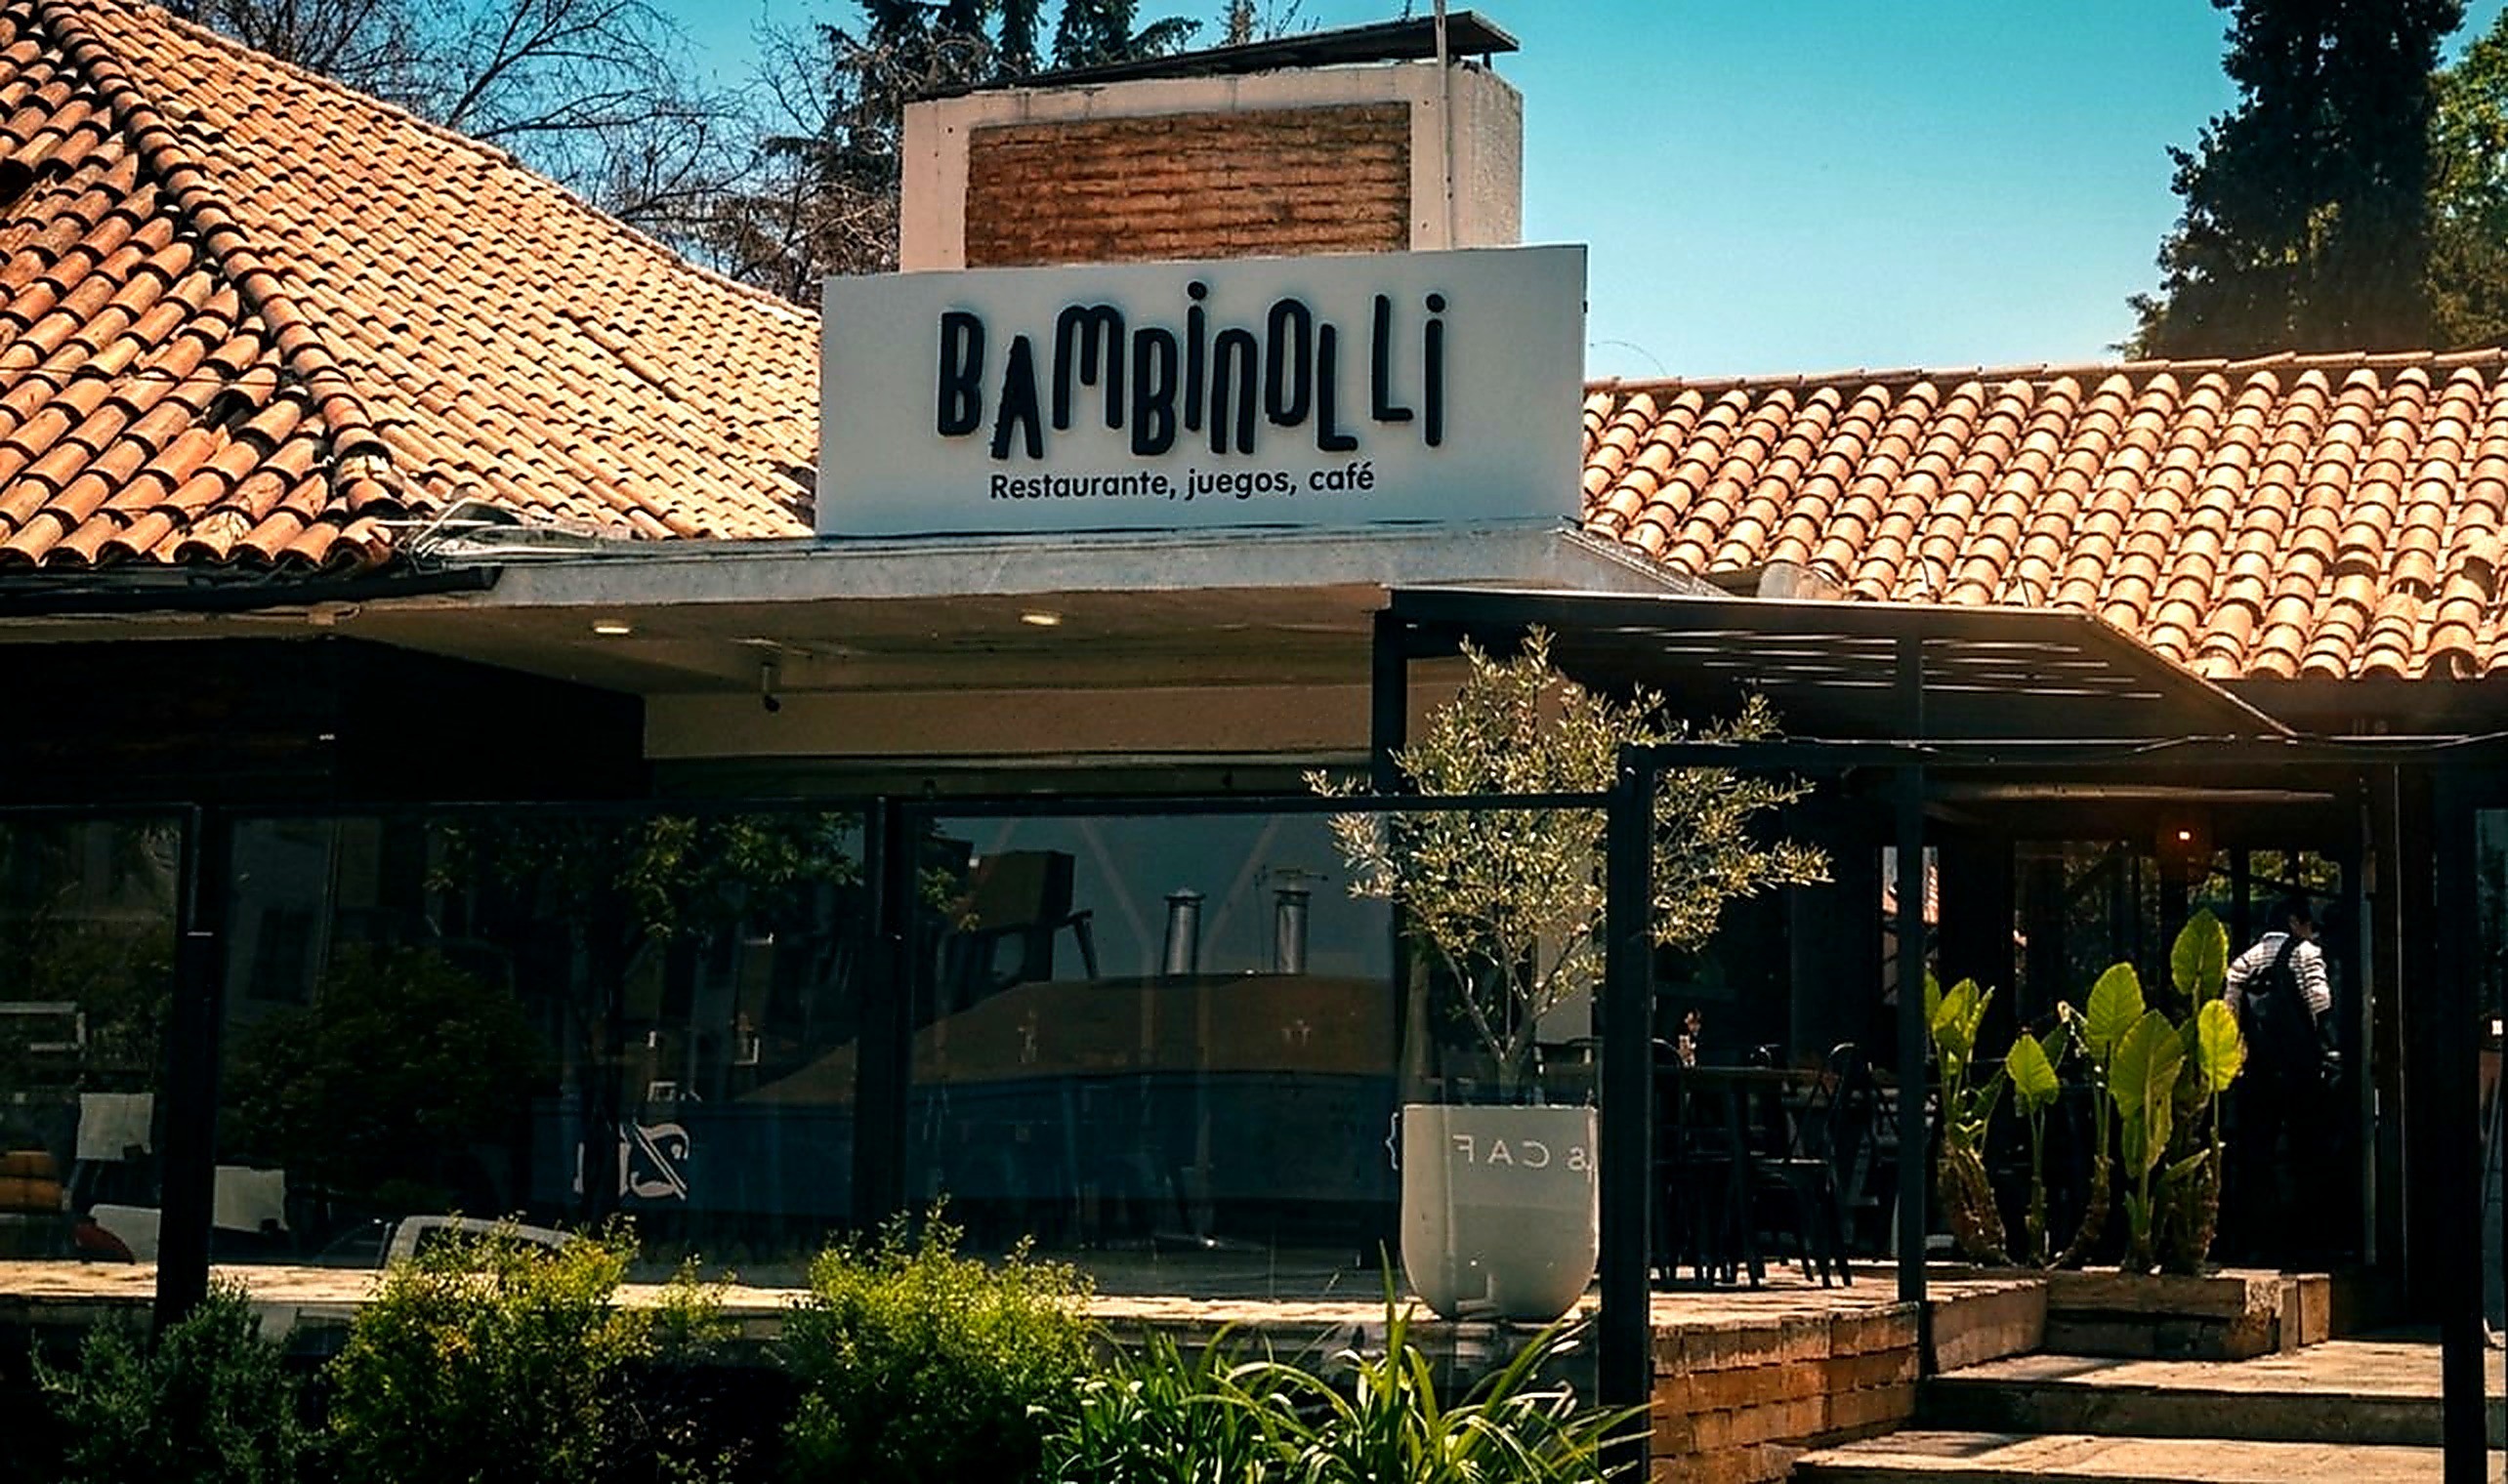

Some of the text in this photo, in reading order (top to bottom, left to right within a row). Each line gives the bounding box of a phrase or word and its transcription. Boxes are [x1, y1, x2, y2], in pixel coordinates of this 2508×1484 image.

[989, 460, 1376, 502] Restaurante, juegos, café
